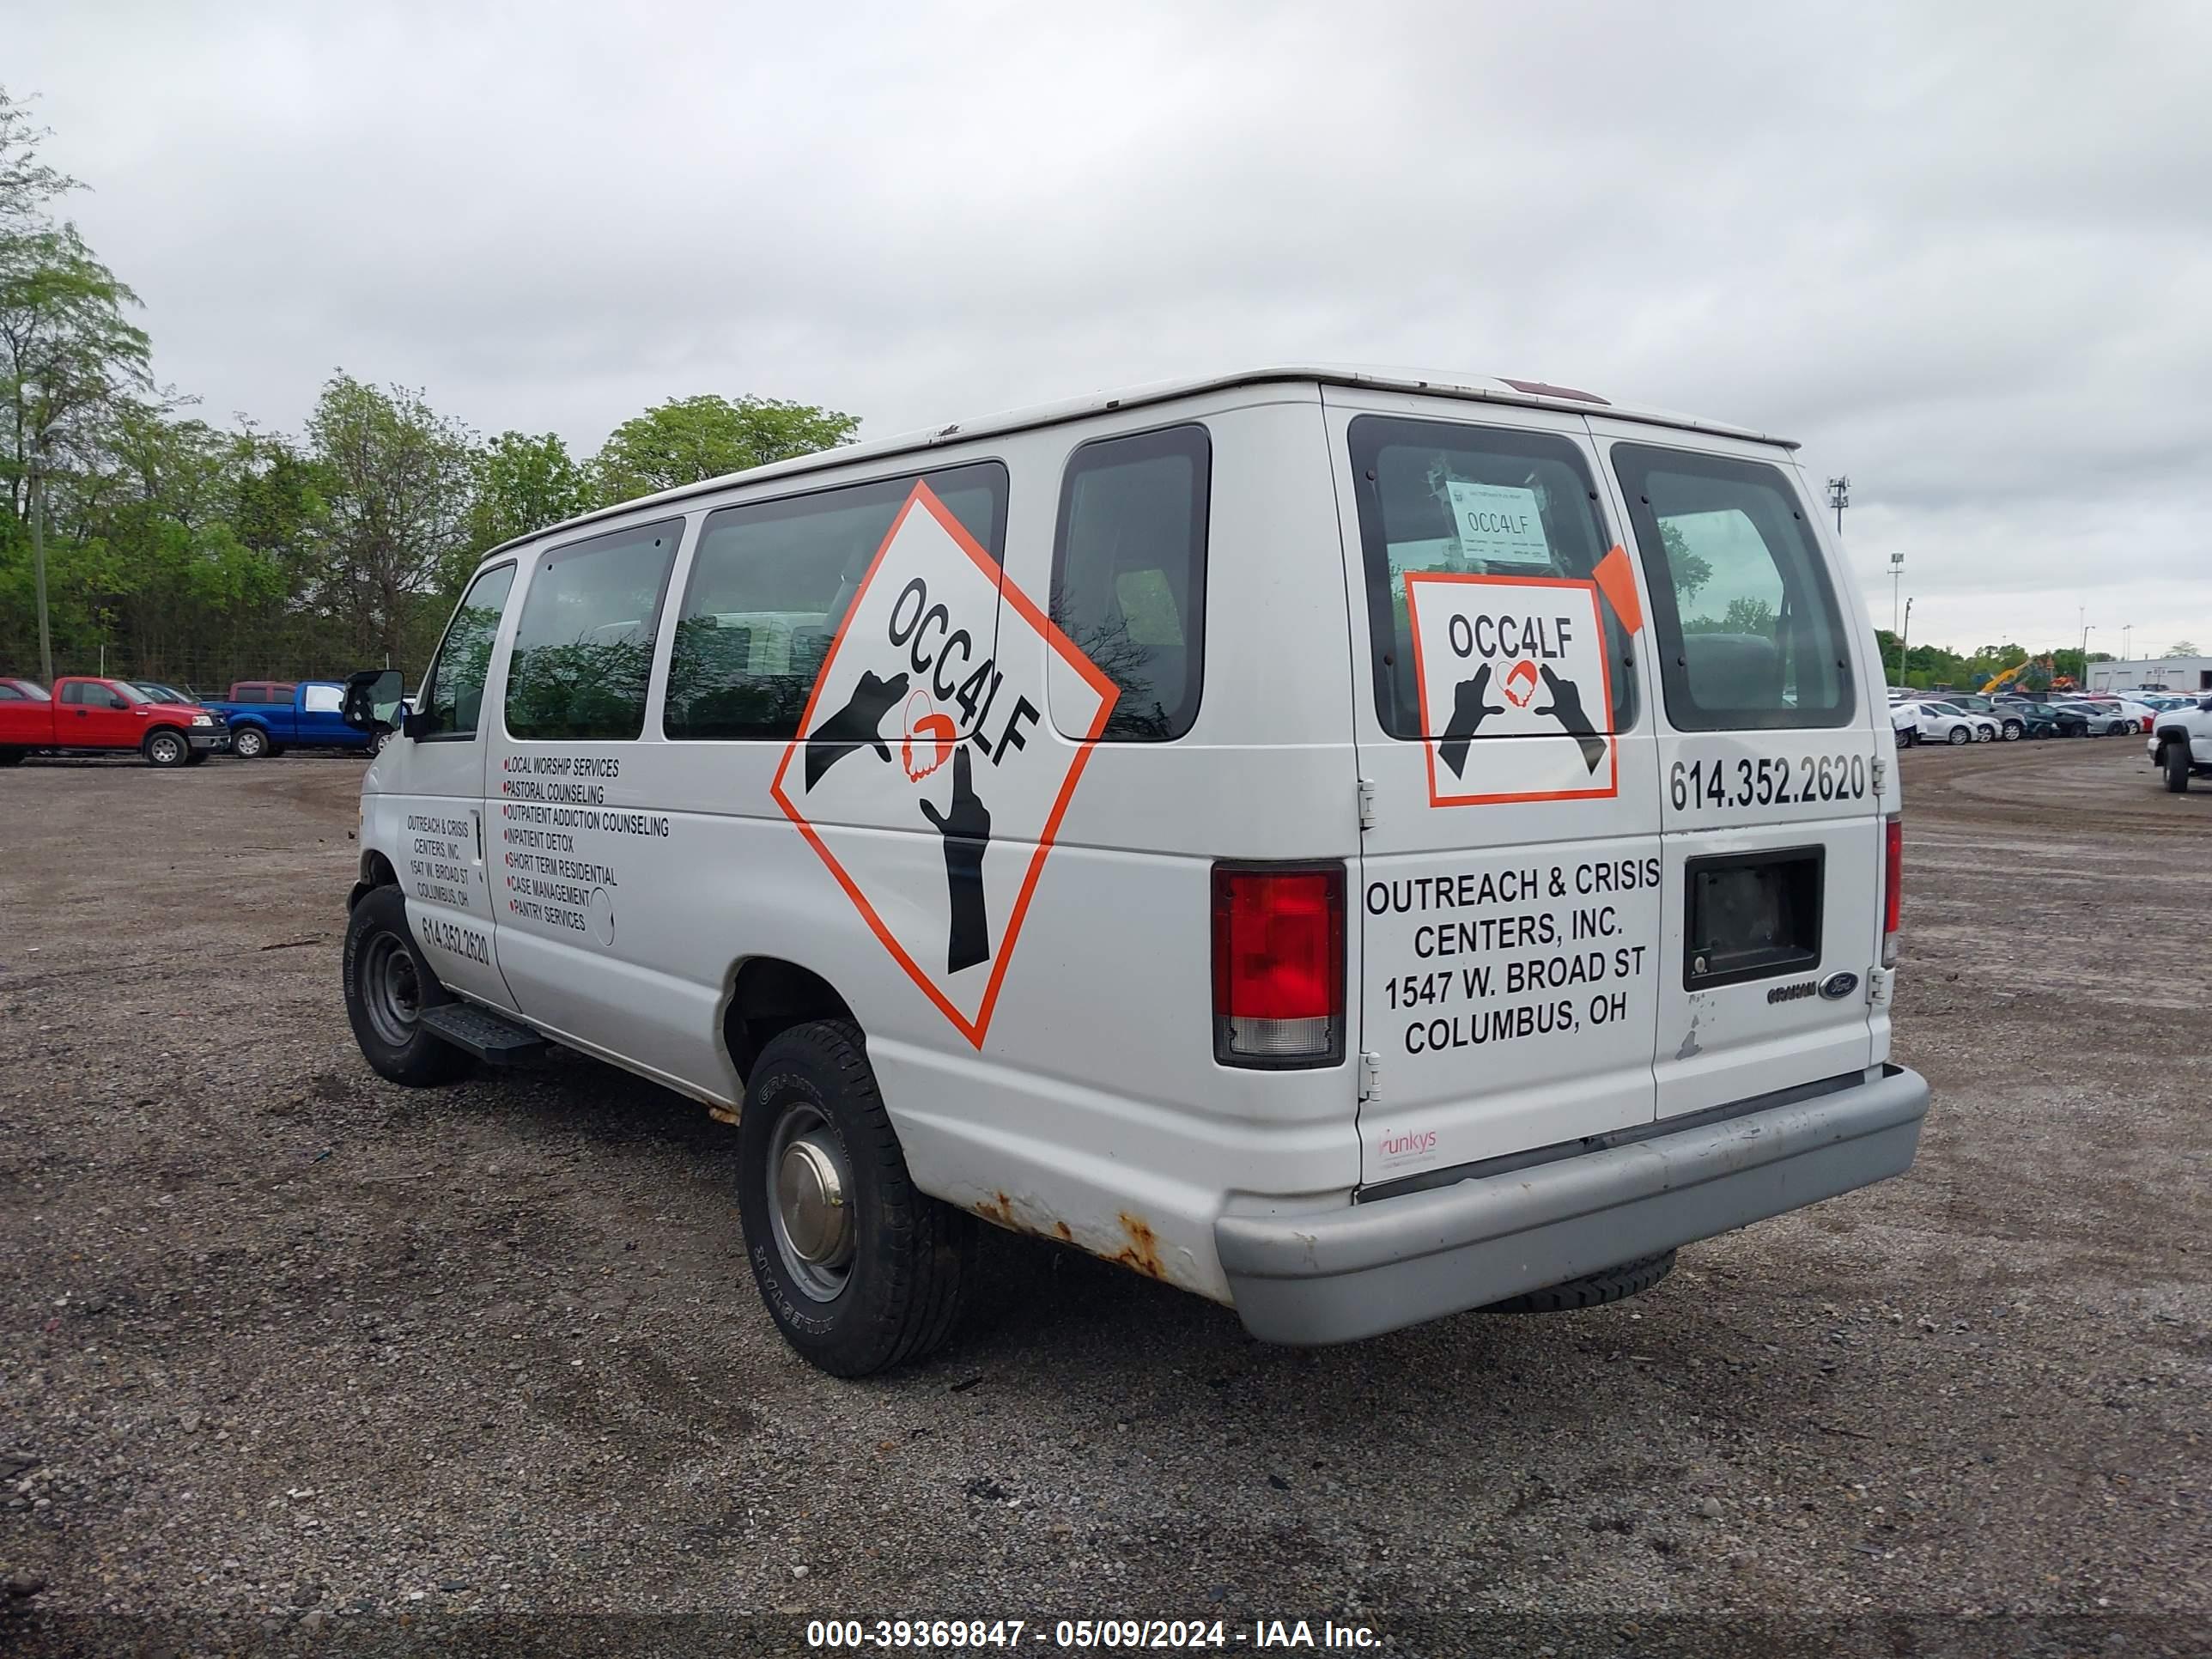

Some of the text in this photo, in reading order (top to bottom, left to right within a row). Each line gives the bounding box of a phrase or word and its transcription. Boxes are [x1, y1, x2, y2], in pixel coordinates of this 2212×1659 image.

[1468, 512, 1528, 534] OCC4LF
[1449, 613, 1572, 659] OCC4LF
[889, 577, 1041, 767] OCC4LF
[507, 757, 620, 778] LOCAL WORSHIP SERVICES
[1670, 754, 1865, 811] 614.352.2620
[507, 780, 605, 805] PASTORAL COUNSELING
[408, 815, 469, 838] OUTREACH & CRISIS
[507, 804, 669, 837] OUTPATIENT ADDICTION COUNSELING
[414, 838, 461, 860] CENTERS, INC.
[507, 828, 574, 853] INPATIENT DETOX
[410, 860, 469, 885] 1547 W. BROAD ST
[508, 851, 618, 886] SHORT TERM RESIDENTIAL
[417, 882, 469, 908] COLUMBUS, OH
[511, 875, 590, 908] CASE MANAGEMENT
[1366, 858, 1660, 915] OUTREACH & CRISIS
[514, 899, 586, 931] PANTRY SERVICES
[422, 916, 490, 967] 614.352.2620
[1415, 906, 1623, 959] CENTERS, INC.
[1384, 945, 1646, 1011] 1547 W. BROAD ST
[1405, 992, 1627, 1054] COLUMBUS, OH
